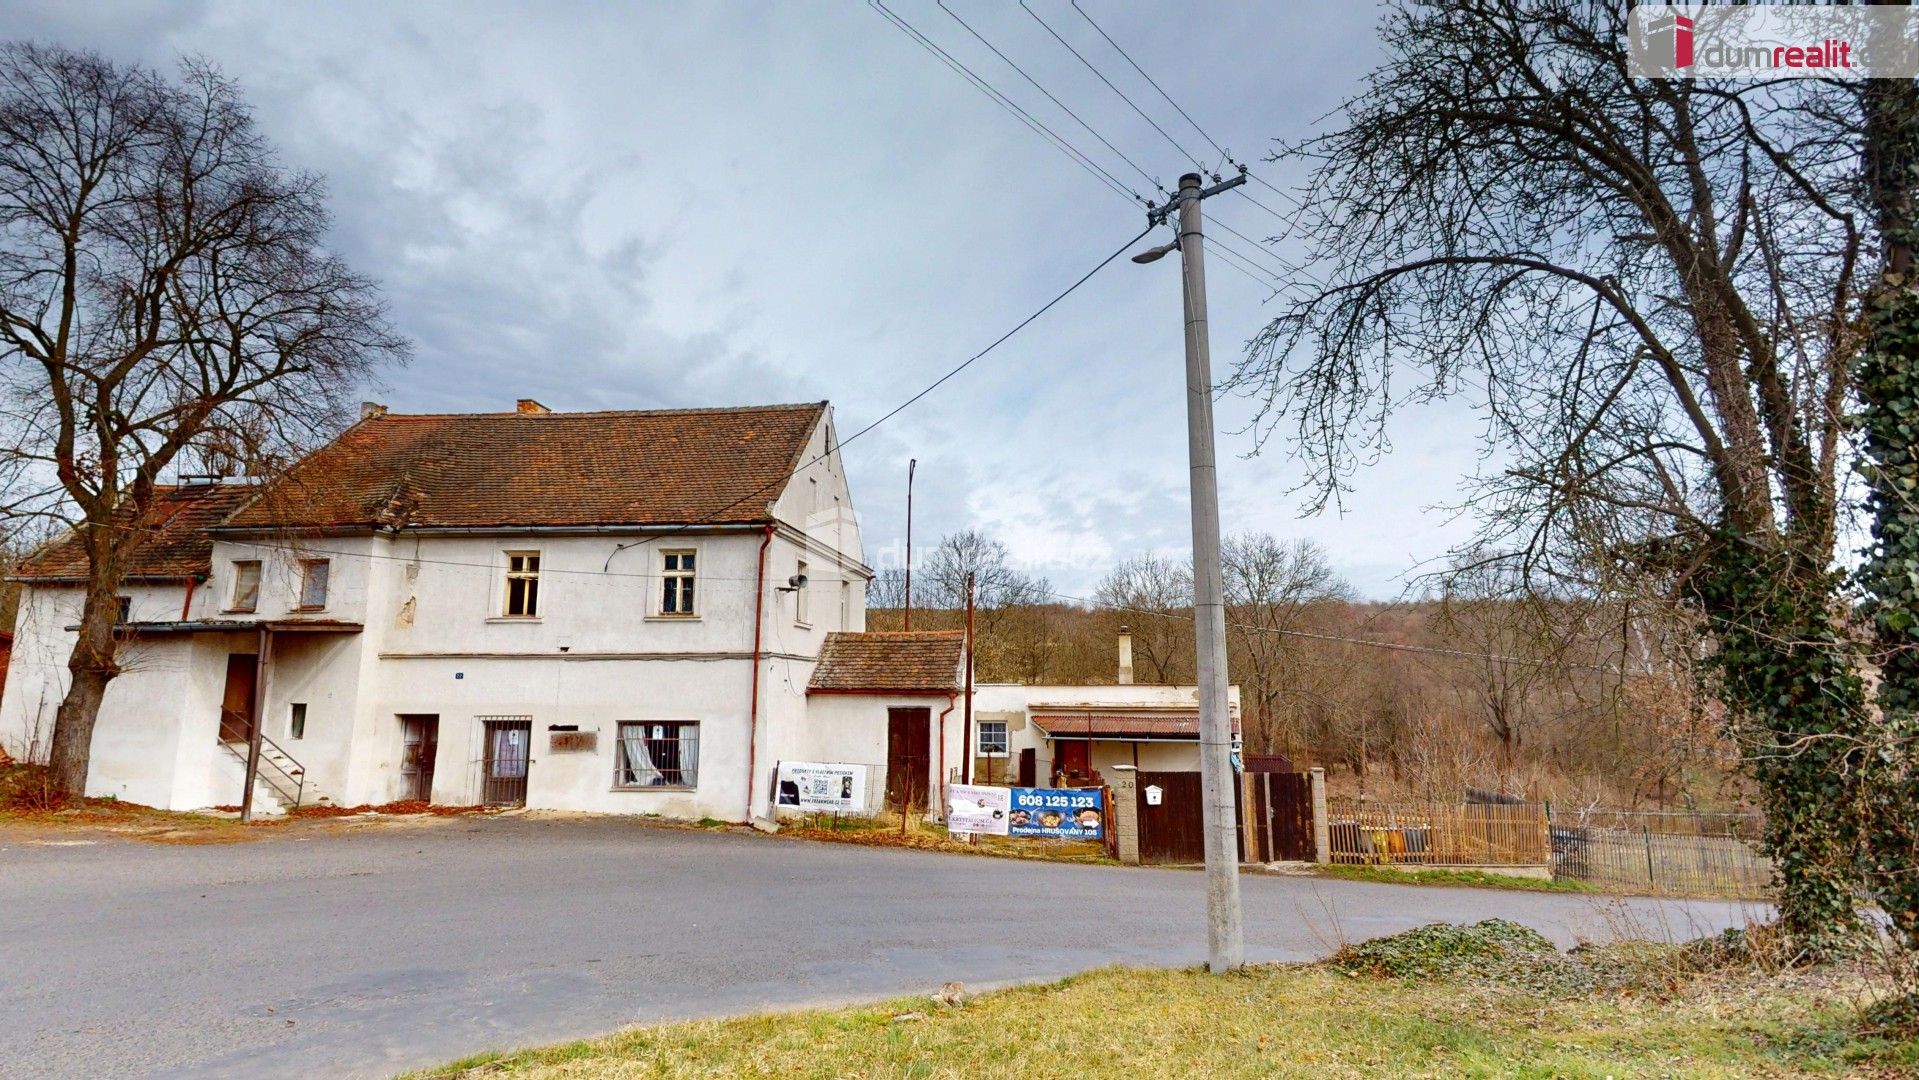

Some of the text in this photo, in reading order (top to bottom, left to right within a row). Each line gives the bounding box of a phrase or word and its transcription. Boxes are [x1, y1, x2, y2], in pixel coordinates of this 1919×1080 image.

[1121, 781, 1134, 789] 20
[1018, 795, 1043, 806] 608
[1045, 796, 1069, 807] 125
[1071, 797, 1094, 808] 123
[1012, 827, 1041, 835] Prodejna
